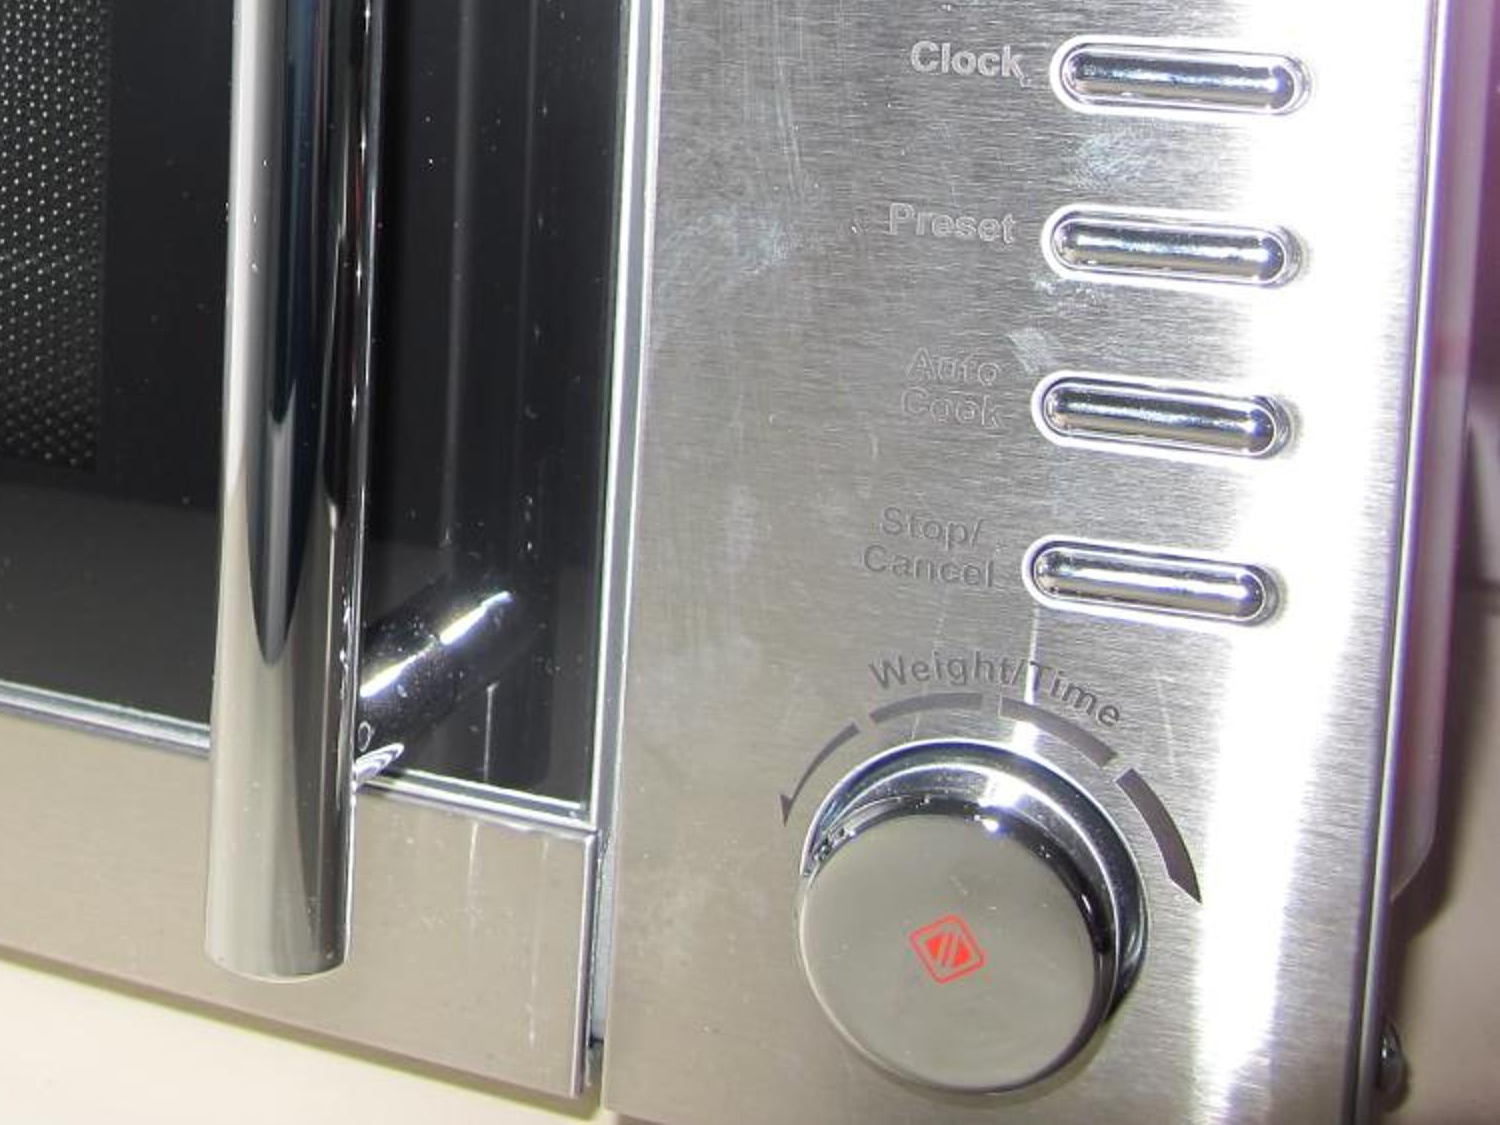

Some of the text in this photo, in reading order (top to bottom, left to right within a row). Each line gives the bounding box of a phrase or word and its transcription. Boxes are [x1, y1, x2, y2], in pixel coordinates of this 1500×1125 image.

[910, 40, 1025, 77] Clock
[888, 202, 1017, 244] Preset
[905, 346, 1000, 387] Auto
[901, 385, 1000, 428] Cook
[881, 506, 985, 551] Stop/
[863, 544, 995, 588] Cancel
[869, 650, 1121, 727] Weight/Time
